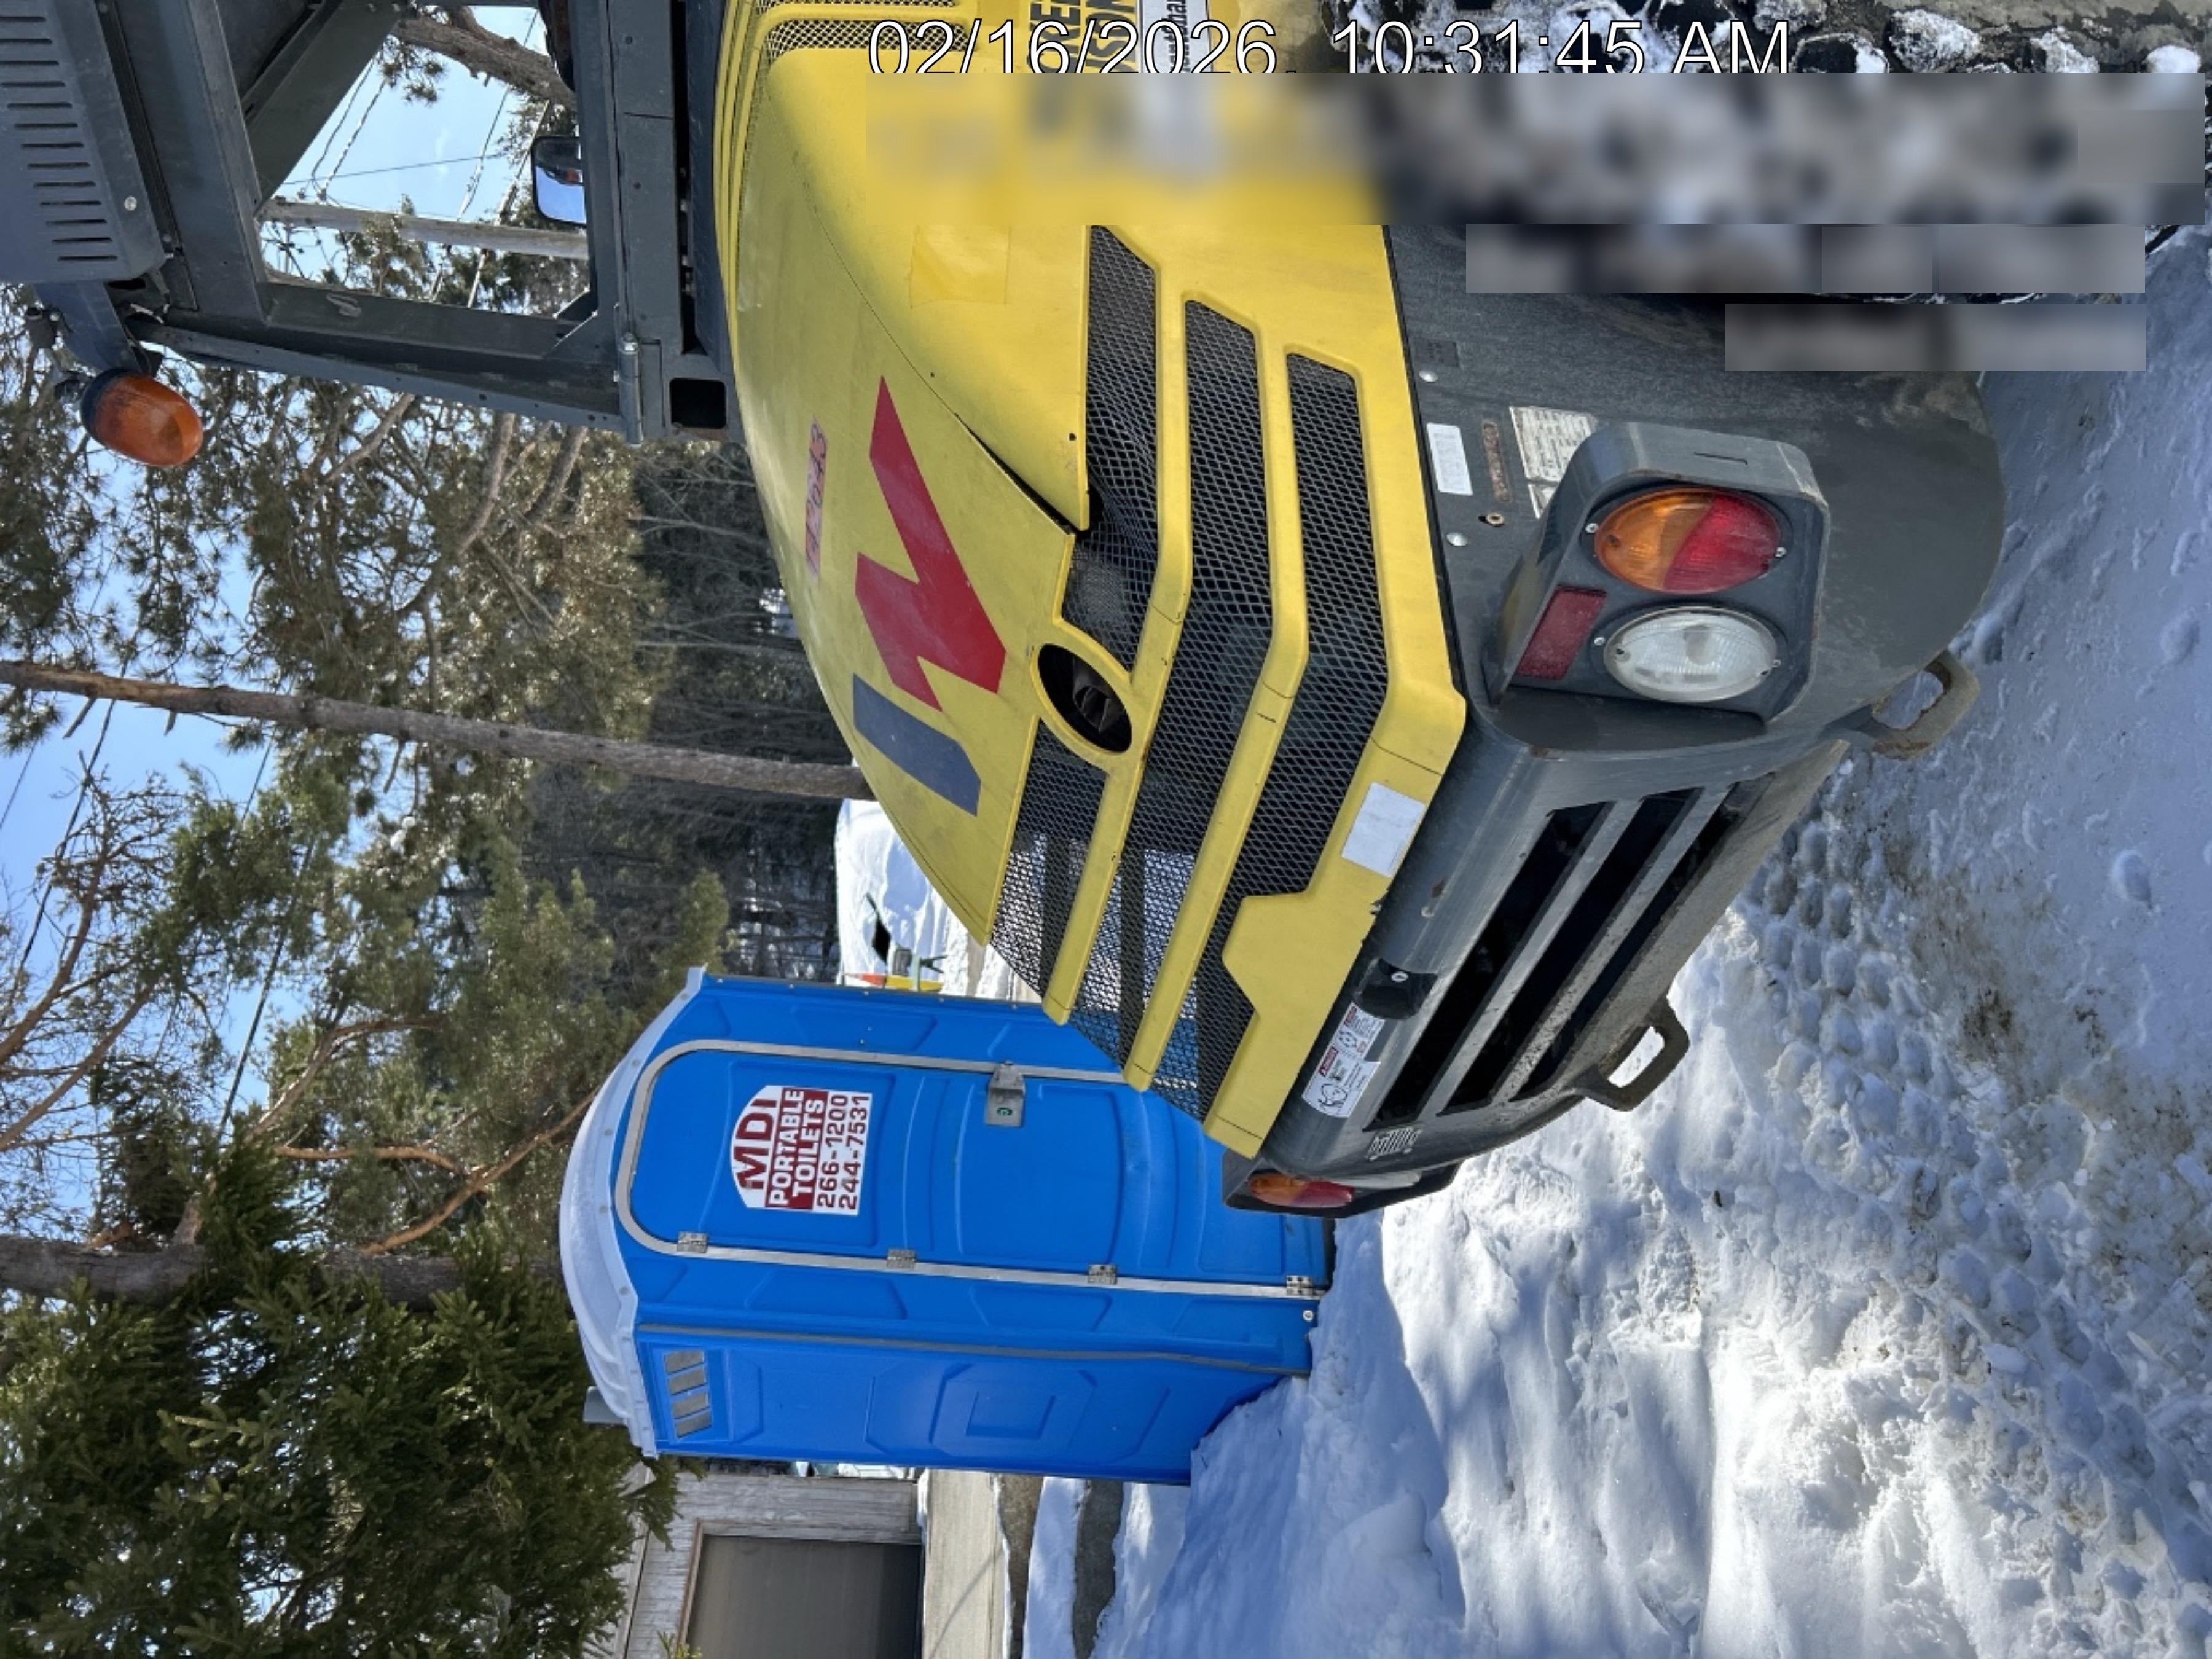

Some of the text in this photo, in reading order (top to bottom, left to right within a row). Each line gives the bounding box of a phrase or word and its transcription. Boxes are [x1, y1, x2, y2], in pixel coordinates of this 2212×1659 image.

[733, 1099, 777, 1190] MDI
[769, 1090, 805, 1206] PORTABLE
[792, 1099, 825, 1198] TOILETS
[817, 1094, 849, 1208] 266-1200
[838, 1096, 871, 1210] 244-7531
